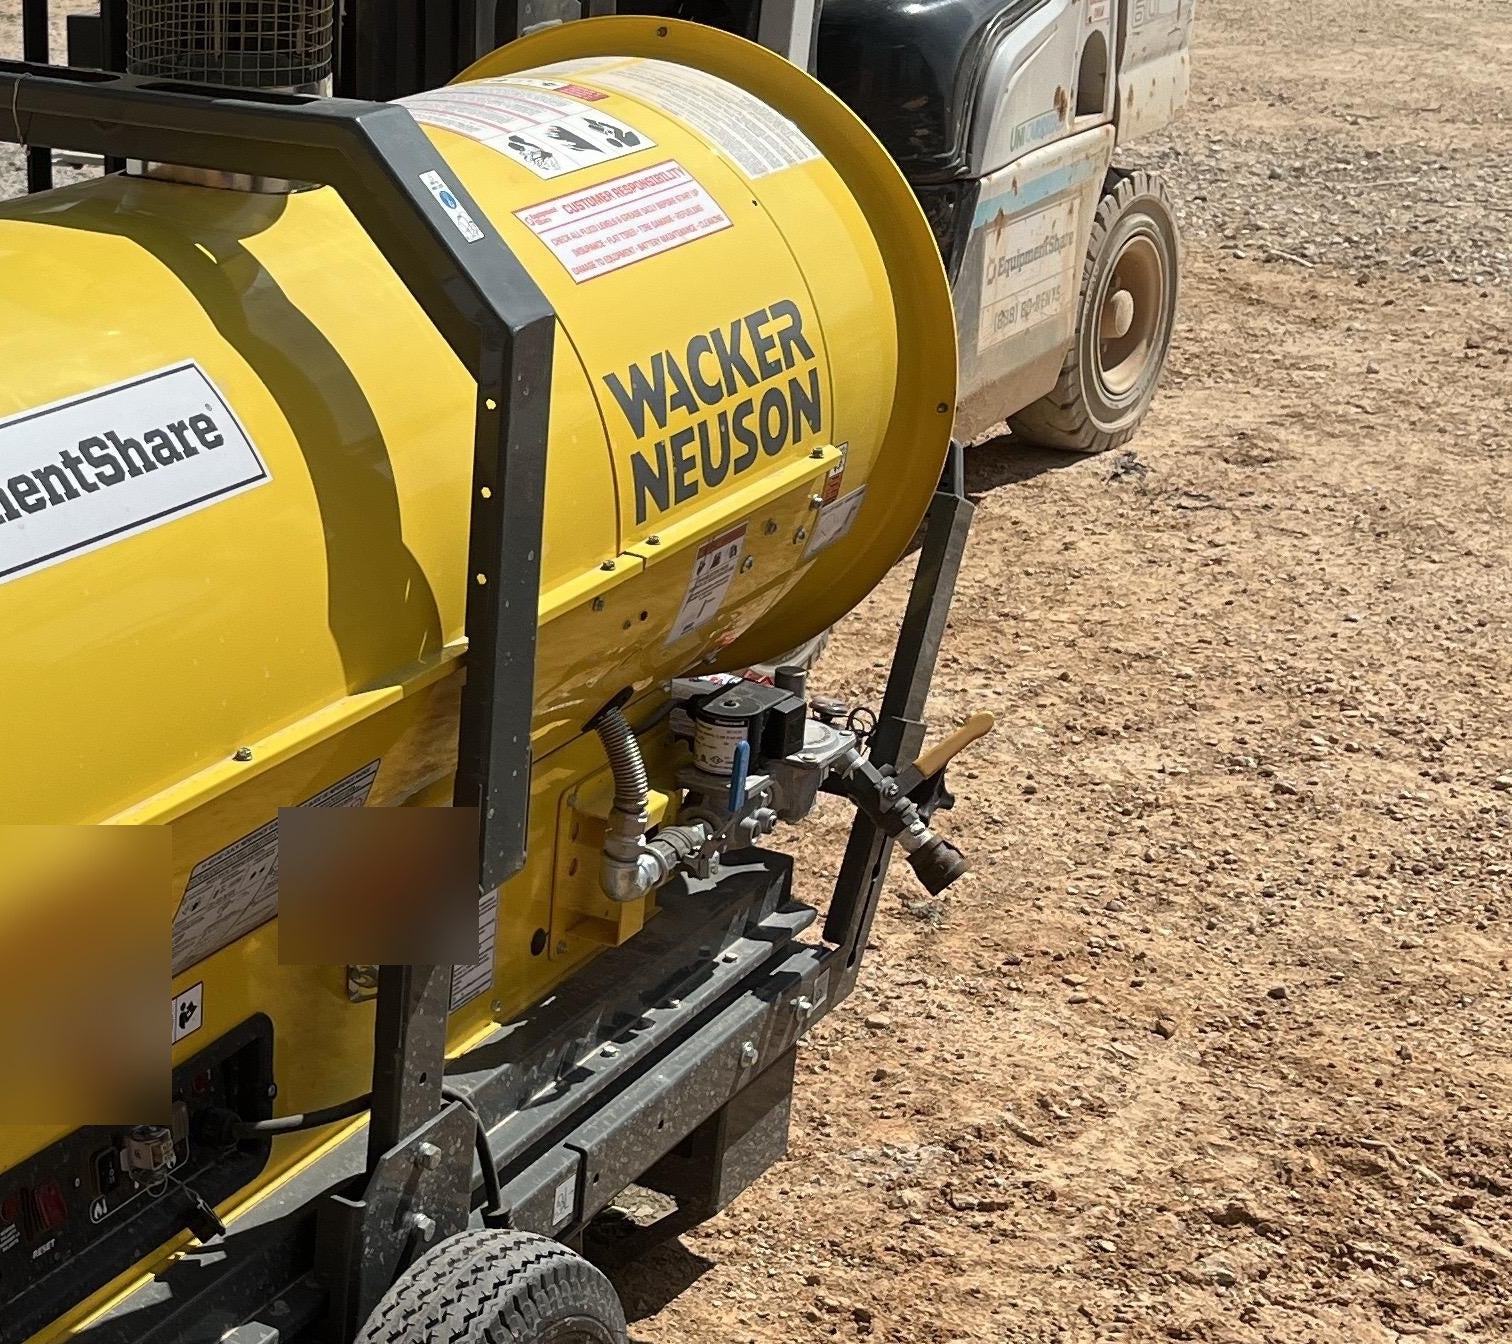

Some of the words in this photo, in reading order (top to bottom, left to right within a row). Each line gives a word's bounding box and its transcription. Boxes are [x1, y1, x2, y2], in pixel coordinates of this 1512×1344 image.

[562, 190, 616, 214] CUSTOMER
[611, 166, 686, 198] RESPONSIBILITY
[998, 231, 1074, 278] EquipmentShare
[602, 299, 816, 440] WACKER
[631, 367, 823, 526] NEUSON
